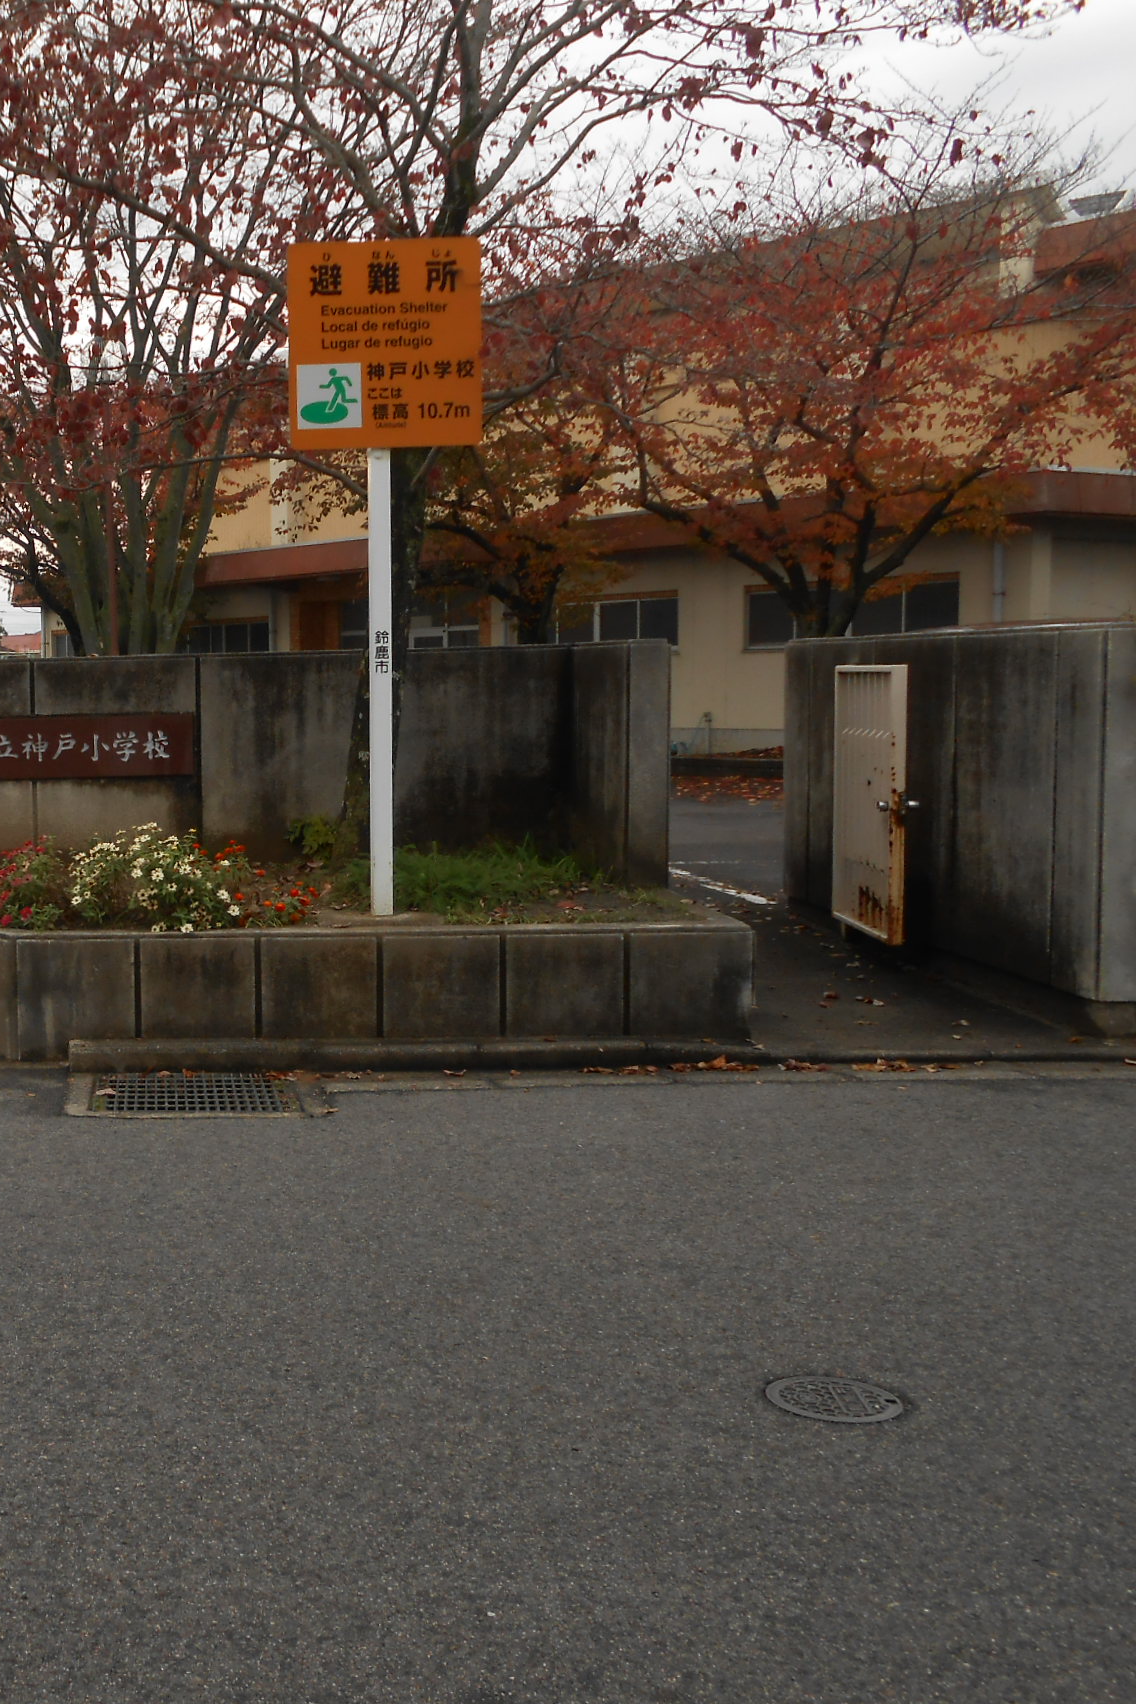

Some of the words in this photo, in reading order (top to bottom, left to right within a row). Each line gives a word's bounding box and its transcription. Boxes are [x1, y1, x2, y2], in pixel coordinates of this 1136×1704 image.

[310, 260, 459, 296] 避難所
[320, 303, 396, 317] Evacuation
[400, 302, 448, 314] Shelter
[321, 321, 358, 333] Local
[362, 320, 378, 331] de
[382, 319, 430, 332] refúgio
[321, 339, 360, 352] Lugar
[364, 337, 381, 348] de
[385, 335, 433, 349] refugio
[367, 360, 474, 381] 神戸小学校
[368, 387, 402, 400] ここは
[418, 402, 470, 419] 10.7m
[374, 630, 389, 674] 鈴鹿市
